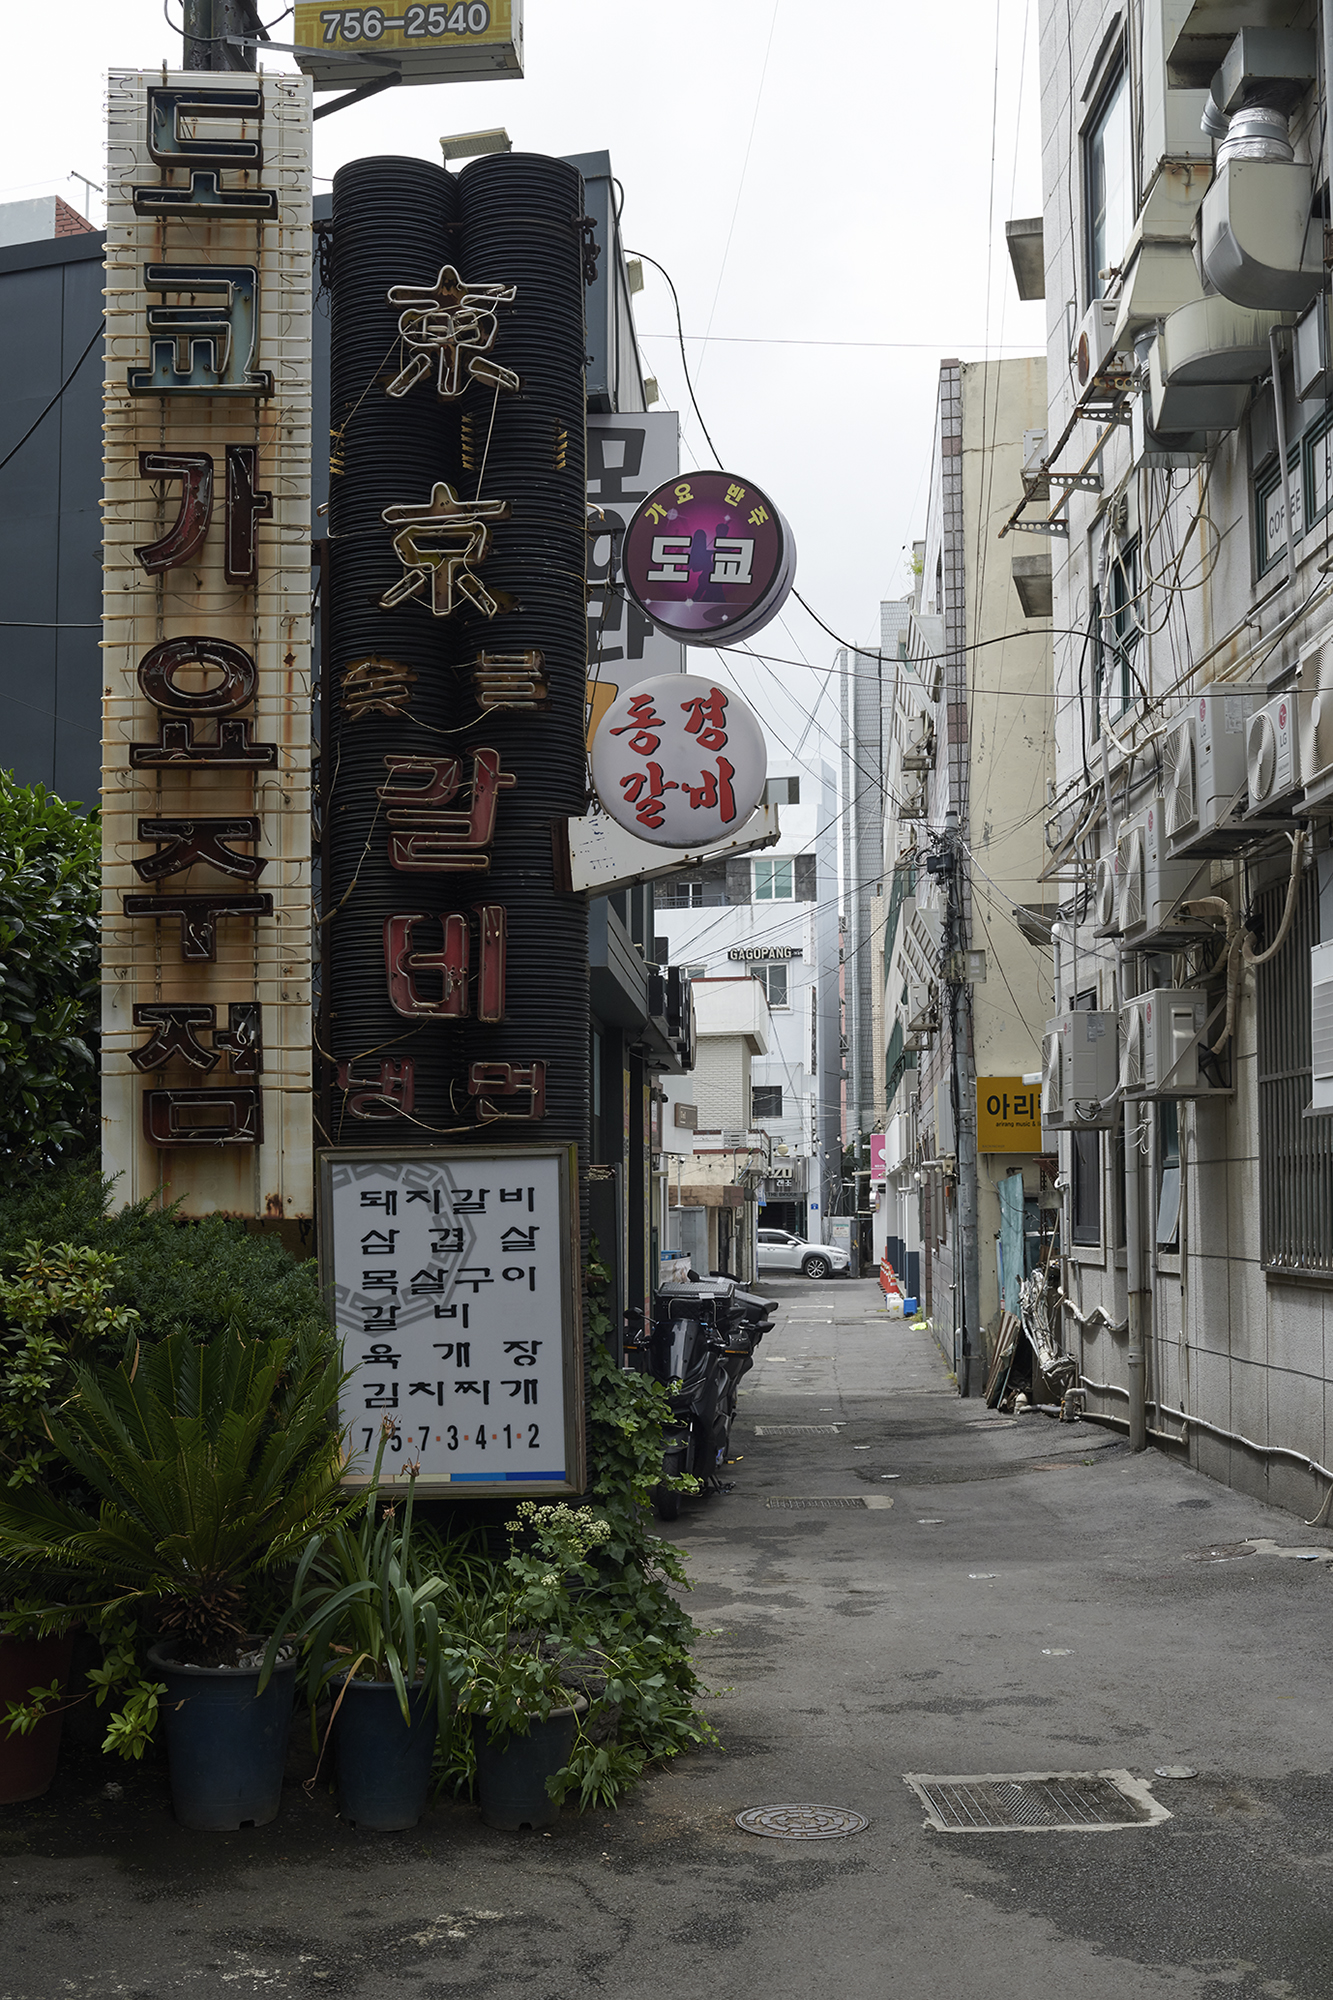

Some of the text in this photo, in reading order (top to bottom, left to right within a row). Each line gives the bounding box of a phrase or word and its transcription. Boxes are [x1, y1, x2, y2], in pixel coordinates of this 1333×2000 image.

[321, 2, 490, 42] 756-2540
[644, 482, 769, 527] 가요 반주
[1268, 488, 1301, 540] COFEE
[646, 535, 756, 585] 도쿄
[123, 86, 278, 1148] 도쿄 가요주점
[609, 687, 729, 756] 동경
[1279, 732, 1288, 748] LG
[619, 756, 737, 830] 갈비
[375, 747, 517, 1024] 갈비
[730, 946, 792, 960] GAGOPANG
[986, 1093, 1041, 1120] 아리
[359, 1186, 535, 1216] 돼지갈비
[360, 1225, 540, 1256] 삼겹살
[361, 1266, 536, 1295] 목살구이
[361, 1303, 470, 1332] 갈비
[361, 1339, 543, 1370] 육개장
[362, 1378, 539, 1409] 김치찌개
